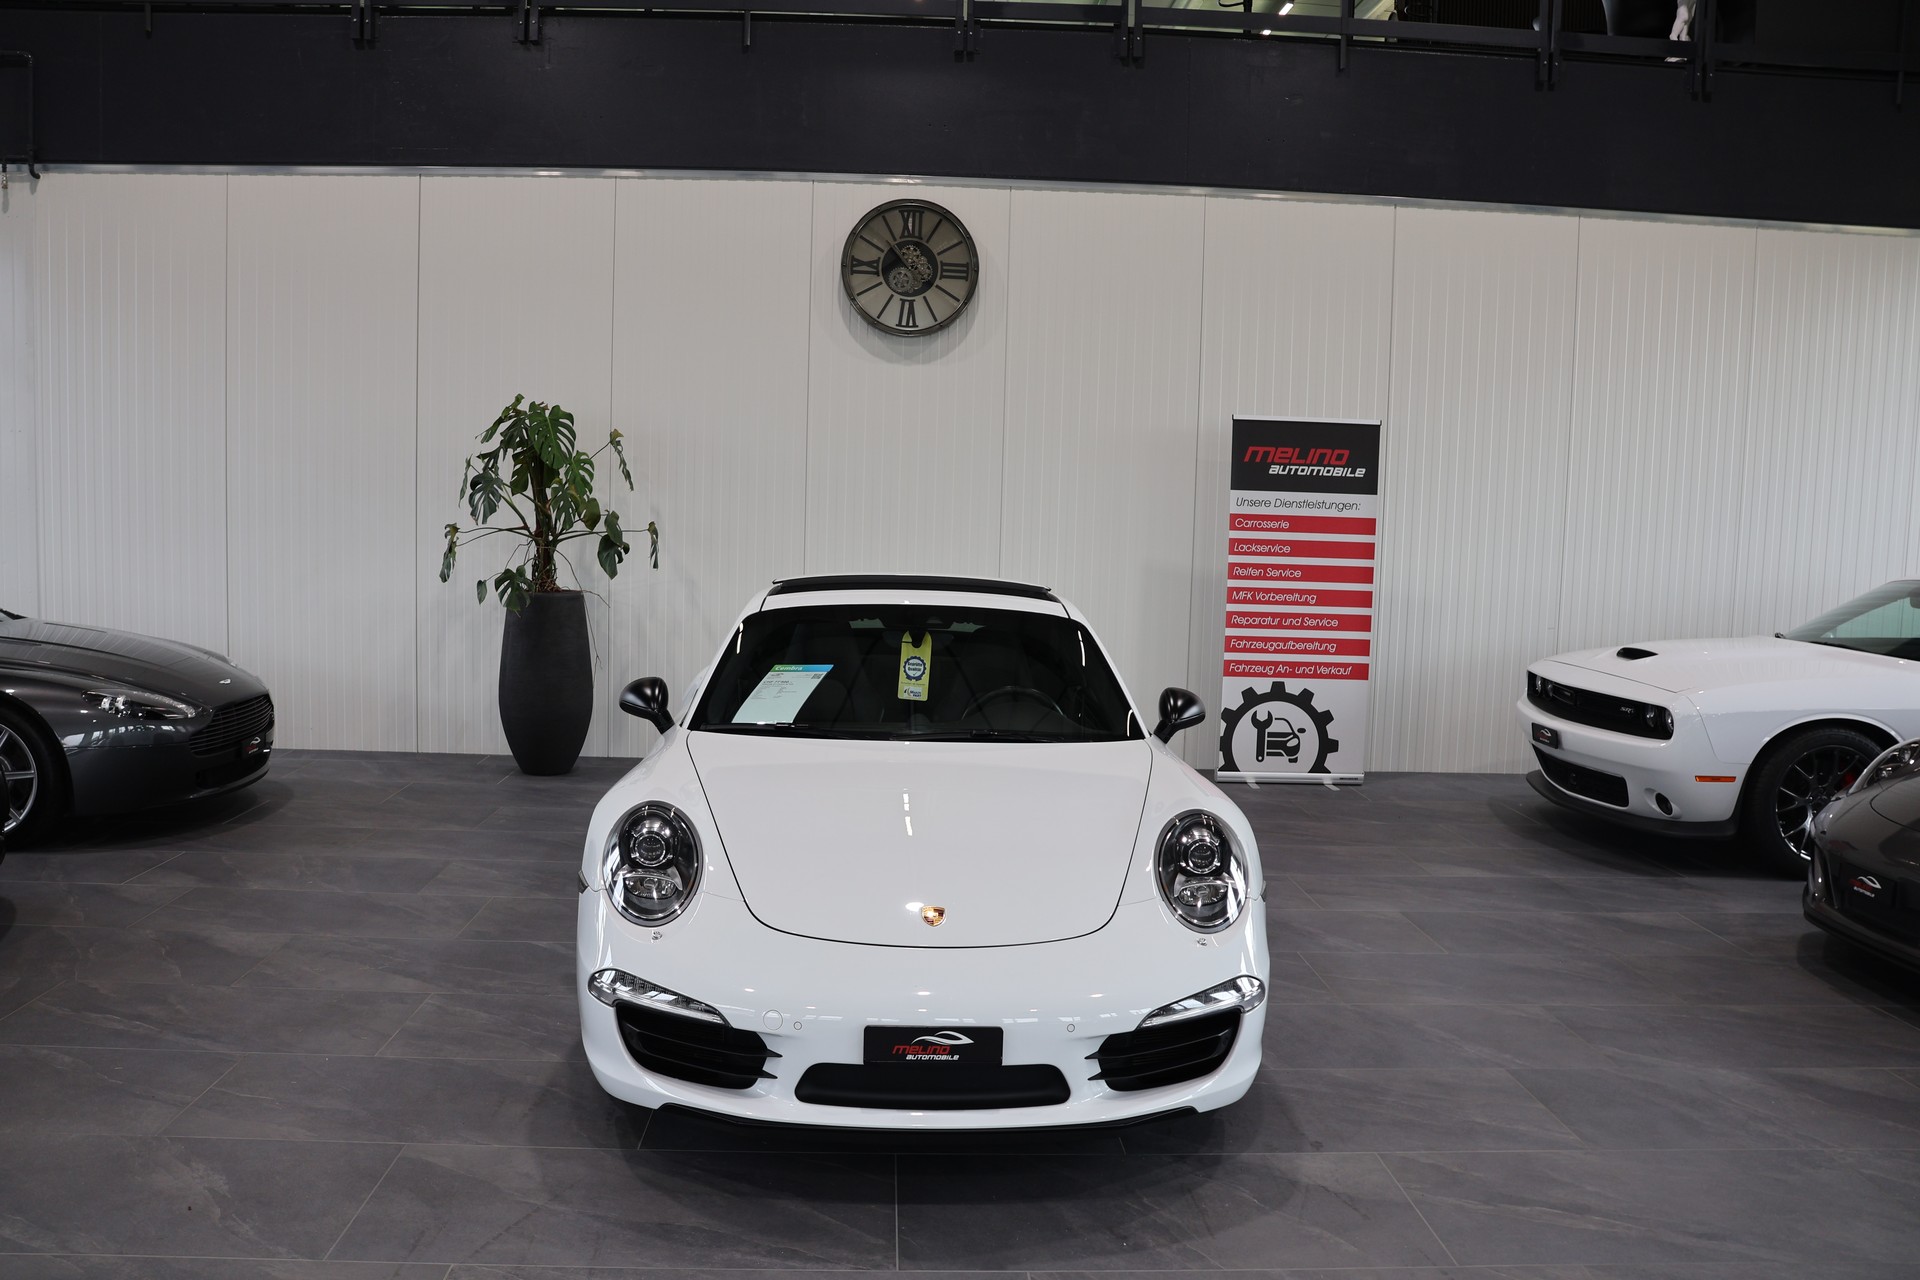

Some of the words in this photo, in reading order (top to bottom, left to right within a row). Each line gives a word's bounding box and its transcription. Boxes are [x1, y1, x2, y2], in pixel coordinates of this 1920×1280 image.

[898, 209, 925, 240] XII
[1243, 446, 1350, 466] MELINO
[1269, 464, 1366, 478] AUTOMOBILE
[1235, 497, 1271, 508] Unsere
[1273, 498, 1361, 513] Dienstleistungen:
[1235, 518, 1290, 529] Carrosserie
[1233, 542, 1291, 553] Lackservice
[1232, 566, 1264, 577] Reifen
[1265, 567, 1302, 578] Service
[1231, 591, 1253, 601] MFK
[1255, 591, 1317, 605] Vorbereitung
[1230, 615, 1280, 627] Reparatur
[1282, 617, 1302, 626] und
[1303, 617, 1339, 627] Service
[1229, 639, 1337, 653] Fahrzeugaufbereitung
[1229, 663, 1275, 675] Fahrzeug
[1275, 664, 1293, 673] An-
[1295, 665, 1314, 674] und
[1316, 665, 1352, 675] Verkauf
